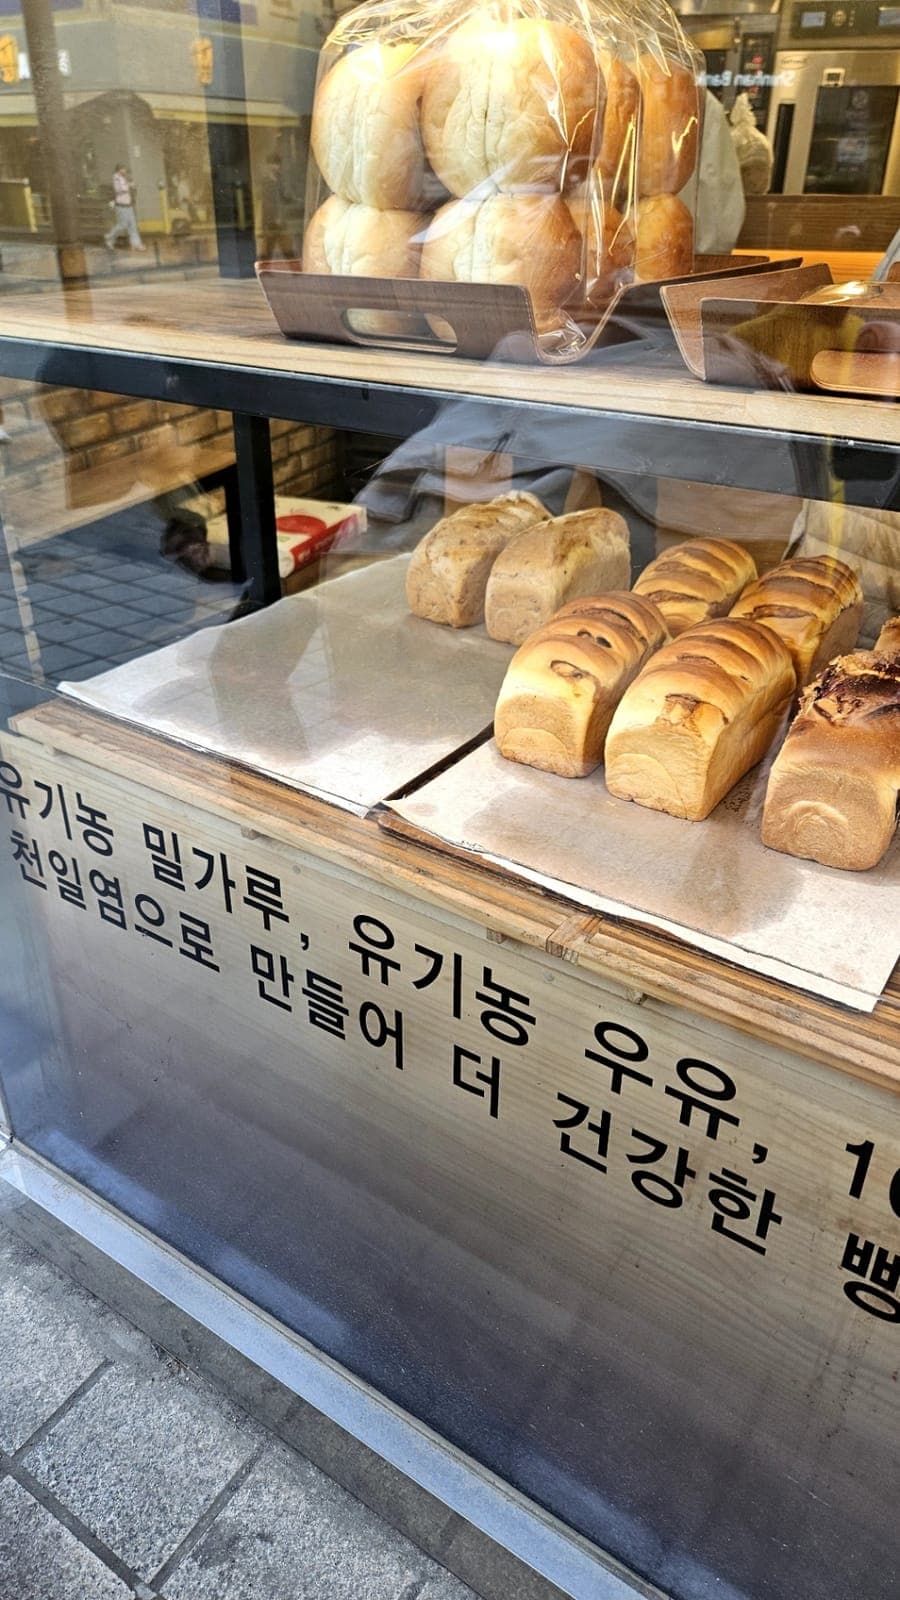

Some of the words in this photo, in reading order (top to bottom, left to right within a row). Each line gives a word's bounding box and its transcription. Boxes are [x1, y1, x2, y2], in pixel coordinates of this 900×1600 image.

[0, 760, 114, 857] 유기농
[143, 823, 309, 951] 밀가루,
[349, 914, 536, 1046] 유기농
[585, 1020, 768, 1164] 우유,
[845, 1140, 900, 1218] 1
[10, 830, 220, 973] 천일염으로
[250, 944, 403, 1071] 만들어
[453, 1044, 500, 1119] 더
[552, 1092, 783, 1256] 건강한
